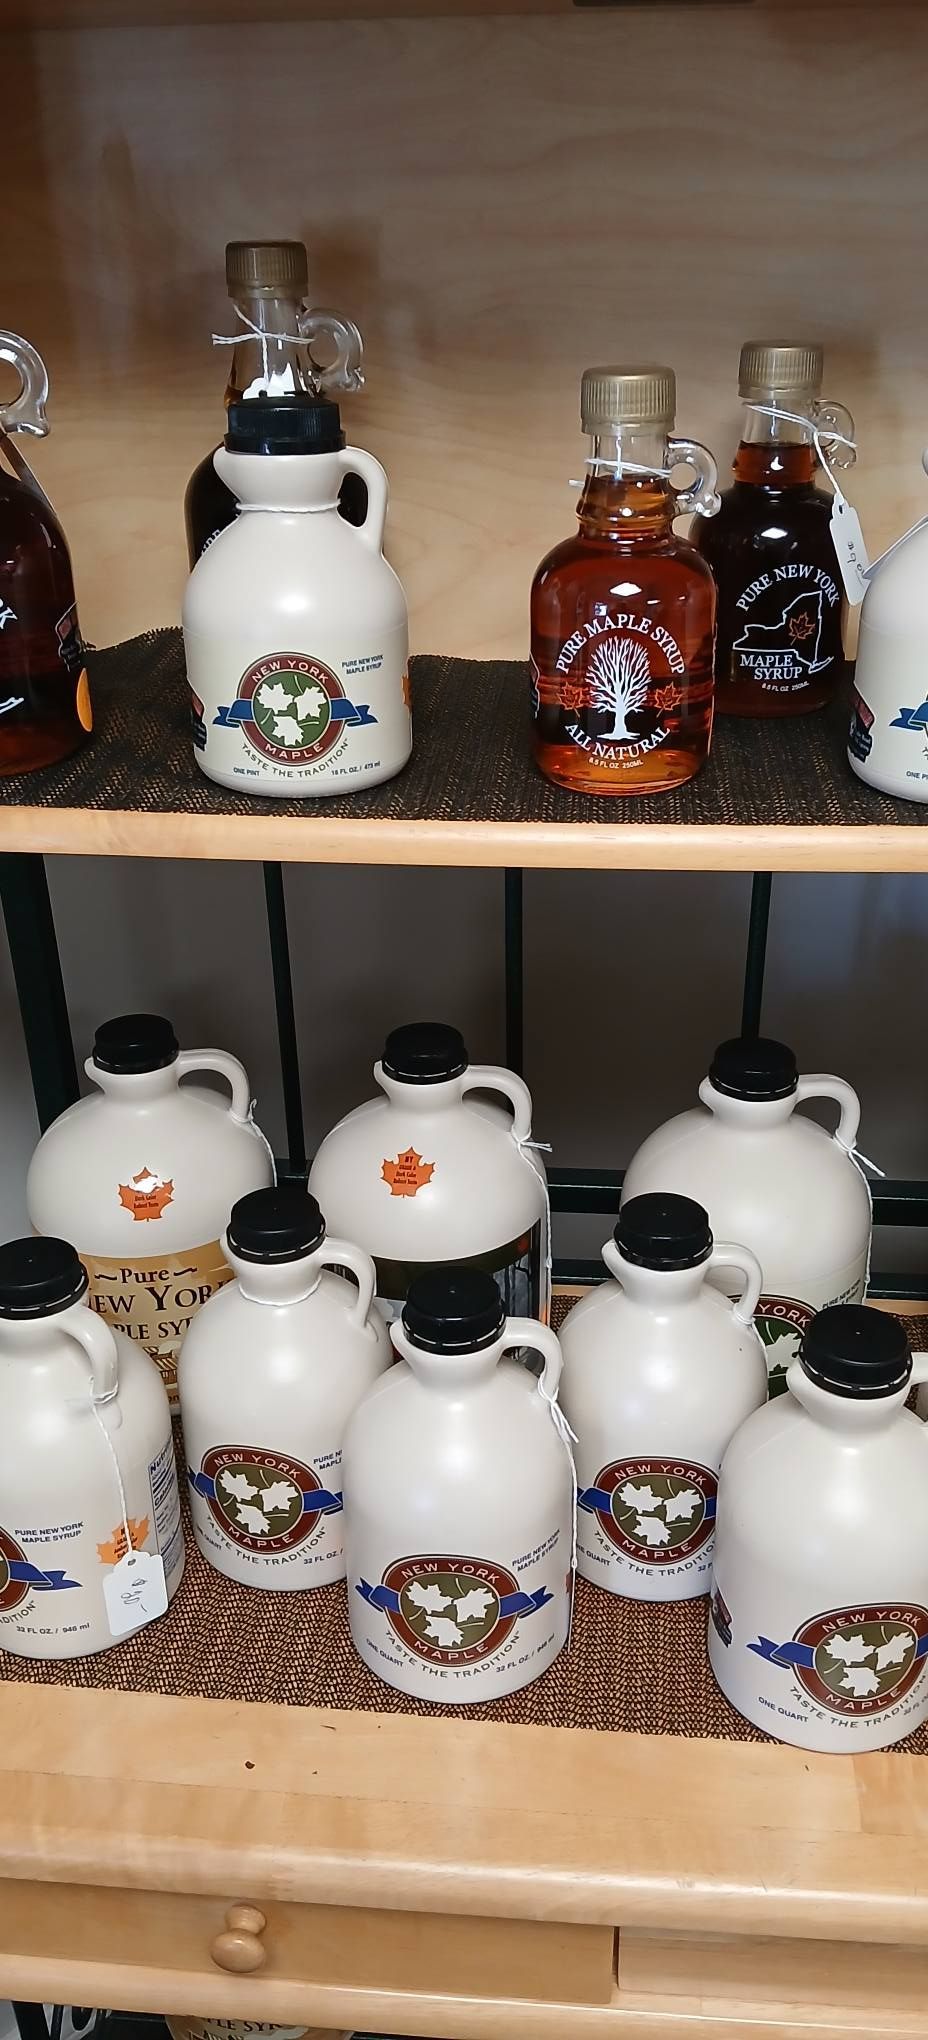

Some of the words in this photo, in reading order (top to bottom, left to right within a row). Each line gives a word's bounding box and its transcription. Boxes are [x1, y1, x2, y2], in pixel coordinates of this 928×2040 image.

[736, 574, 773, 611] PURE
[773, 564, 814, 581] NEW
[813, 569, 840, 608] YORK
[556, 631, 587, 674] PURE
[583, 614, 652, 638] MAPLE
[650, 626, 685, 674] SYRUP
[342, 660, 357, 668] PURE
[358, 657, 370, 665] NEW
[740, 654, 793, 667] MAPLE
[252, 661, 281, 683] NEW
[287, 660, 329, 683] YORK
[346, 666, 365, 674] MAPLE
[754, 666, 802, 680] SYRUP
[265, 742, 324, 760] MAPLE
[564, 724, 591, 751] ALL
[592, 727, 671, 760] NATURAL
[241, 744, 269, 770] TASTE
[272, 767, 294, 778] THE
[622, 760, 643, 769] 250ML
[233, 767, 244, 775] ONE
[245, 768, 260, 776] PINT
[906, 771, 920, 779] ONE
[120, 1268, 170, 1284] Pure
[759, 1303, 811, 1328] YORK
[214, 1453, 243, 1467] NEW
[251, 1455, 301, 1478] YORK
[313, 1454, 334, 1466] PURE
[614, 1464, 651, 1480] NEW
[660, 1465, 707, 1486] YORK
[15, 1529, 37, 1537] PURE
[39, 1527, 59, 1536] NEW
[60, 1521, 84, 1533] YORK
[22, 1535, 52, 1543] MAPLE
[53, 1530, 82, 1542] SYRUP
[228, 1526, 294, 1548] MAPLE
[236, 1549, 260, 1564] THE
[586, 1551, 611, 1566] QUART
[594, 1531, 624, 1564] TASTE
[628, 1563, 654, 1576] THE
[660, 1541, 716, 1577] TRADITIO
[622, 1540, 692, 1559] MAPLE
[401, 1563, 438, 1579] NEW
[448, 1563, 500, 1584] YORK
[27, 1626, 37, 1634] FL
[822, 1613, 865, 1633] NEW
[876, 1611, 921, 1626] YORK
[385, 1630, 416, 1666] TASTE
[421, 1665, 449, 1679] THE
[414, 1643, 489, 1661] MAPLE
[507, 1661, 517, 1669] FL
[790, 1686, 828, 1720] TASTE
[830, 1718, 859, 1728] THE
[826, 1687, 901, 1710] MAPLE
[758, 1696, 776, 1710] ONE
[778, 1707, 809, 1723] QUART
